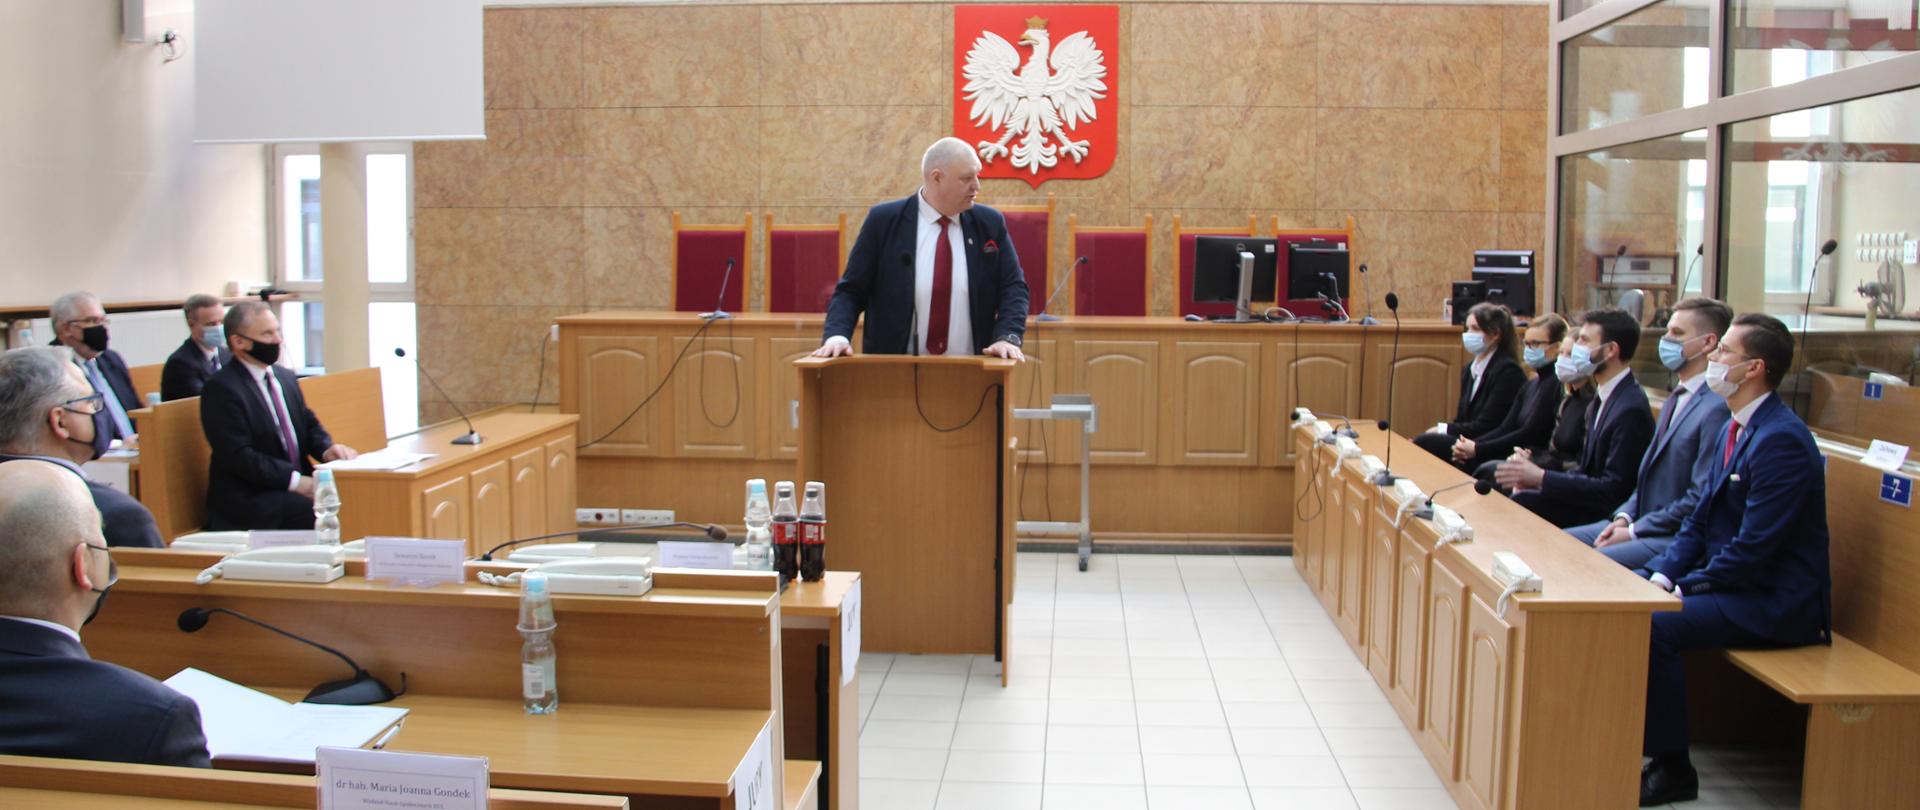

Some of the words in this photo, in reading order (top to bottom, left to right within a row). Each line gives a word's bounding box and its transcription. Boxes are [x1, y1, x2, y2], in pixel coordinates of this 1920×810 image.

[336, 779, 347, 789] dr
[348, 780, 369, 791] hab.
[370, 782, 398, 793] Maria
[399, 784, 432, 796] Joanna
[433, 787, 471, 799] Gondek
